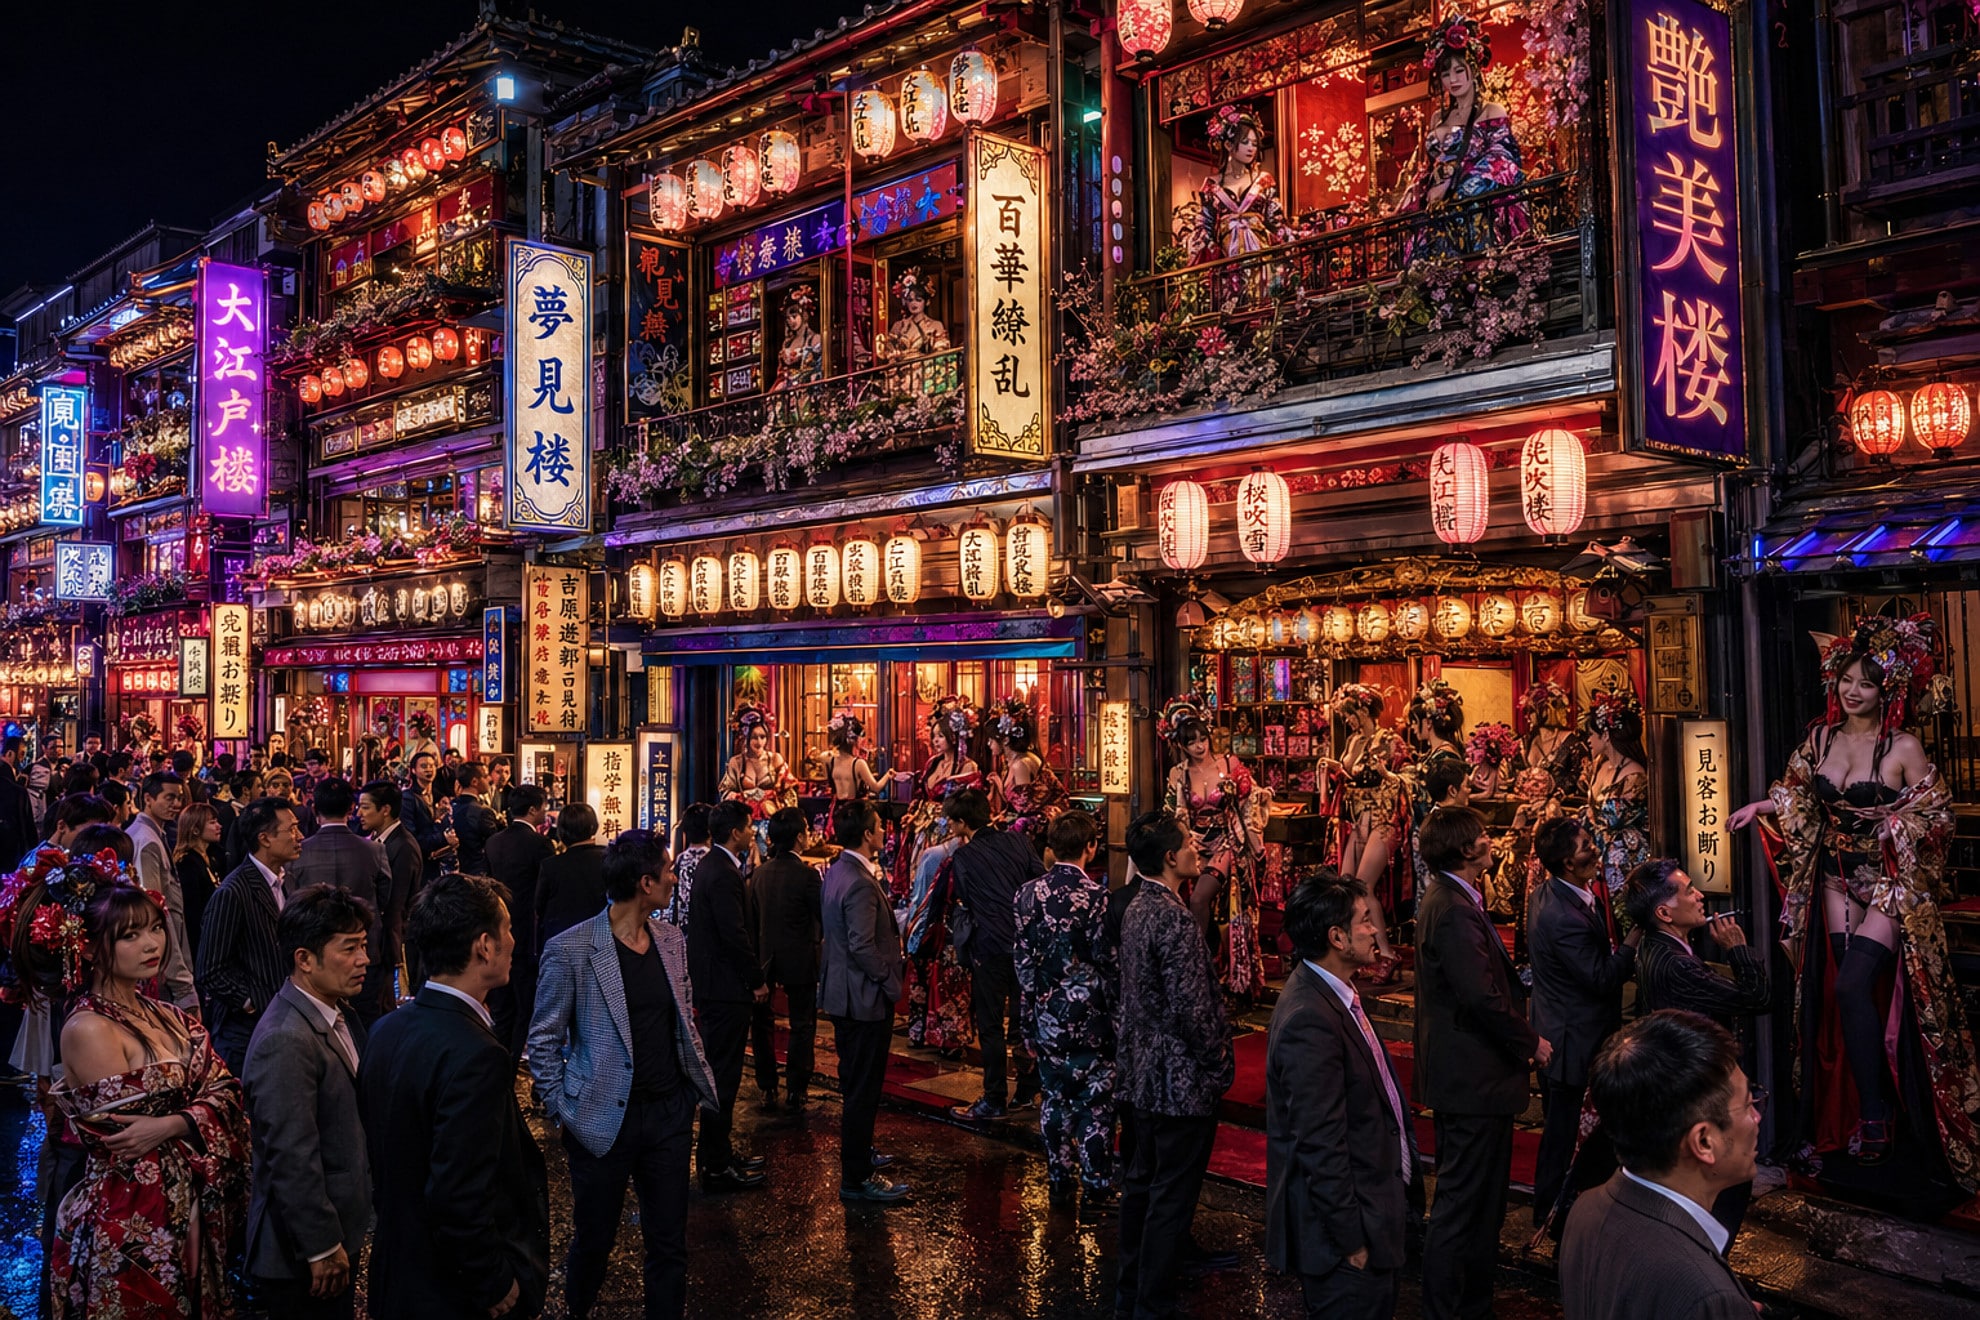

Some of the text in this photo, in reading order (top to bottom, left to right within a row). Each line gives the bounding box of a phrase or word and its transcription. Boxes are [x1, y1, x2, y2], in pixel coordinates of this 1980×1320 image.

[524, 284, 575, 488] 夢見楼
[990, 192, 1031, 398] 百華繚乱
[1695, 731, 1720, 883] 一見客お断り
